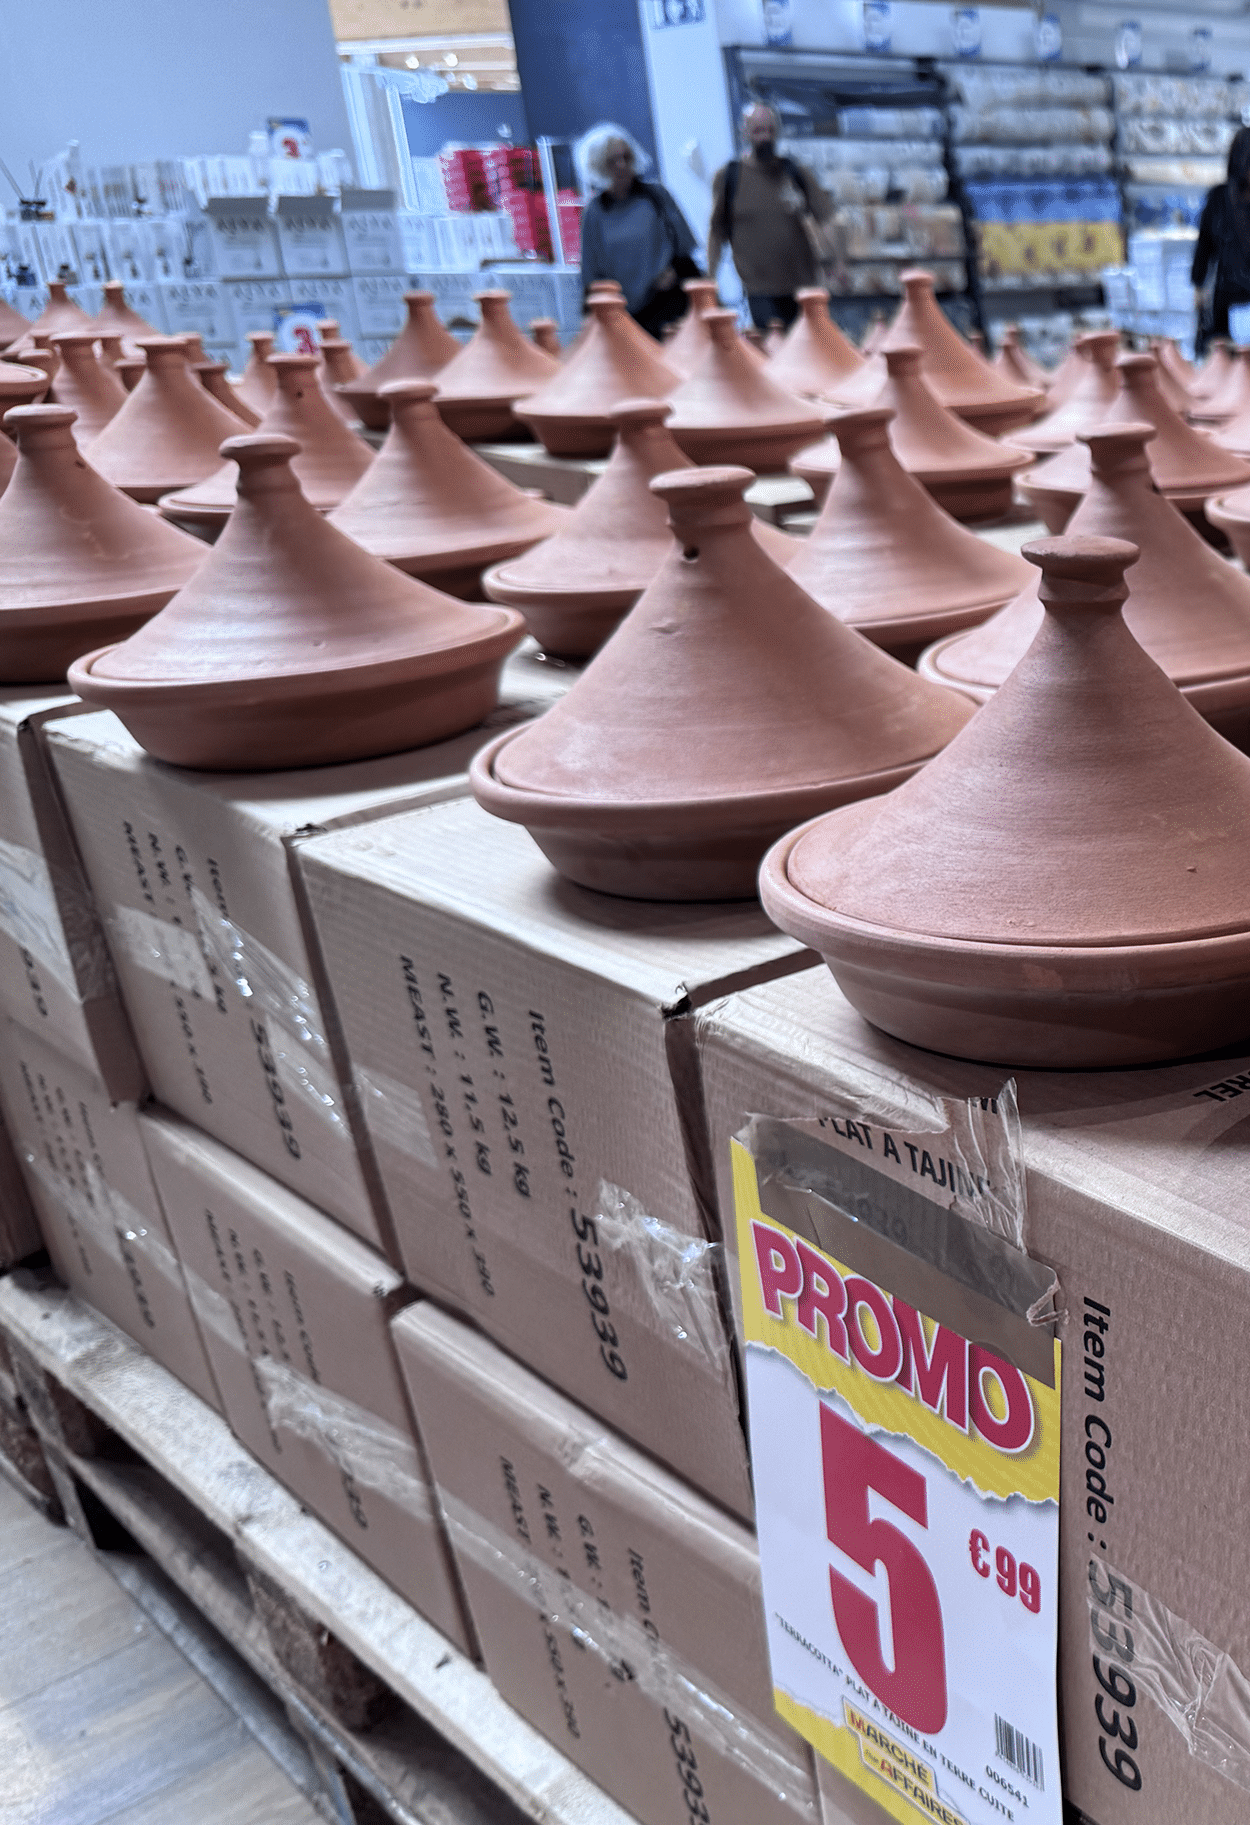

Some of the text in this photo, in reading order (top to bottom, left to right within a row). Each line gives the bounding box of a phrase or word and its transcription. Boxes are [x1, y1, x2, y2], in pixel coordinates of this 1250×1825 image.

[248, 1017, 303, 1162] 53939
[399, 954, 437, 1061] MEAST
[428, 1082, 454, 1139] 280
[435, 971, 464, 1039] N.W.
[473, 1140, 493, 1177] kg
[475, 990, 504, 1058] G.W.
[511, 1161, 532, 1201] kg
[526, 1009, 556, 1088] Item
[546, 1095, 576, 1180] Code
[568, 1206, 630, 1383] 53939
[883, 1132, 902, 1165] A
[750, 1218, 1035, 1453] PROMO
[1083, 1295, 1112, 1403] Item
[1084, 1413, 1115, 1525] Code
[626, 1547, 652, 1615] Item
[818, 1398, 949, 1736] 5
[1088, 1554, 1143, 1793] 53939
[662, 1706, 711, 1825] 5393
[845, 1675, 870, 1702] PLAT
[883, 1705, 921, 1745] TAJINE
[922, 1738, 938, 1759] EN
[939, 1752, 976, 1790] TERRE
[978, 1785, 1015, 1822] CUITE
[849, 1709, 930, 1786] MARCHÉ
[985, 1764, 1030, 1809] 006541
